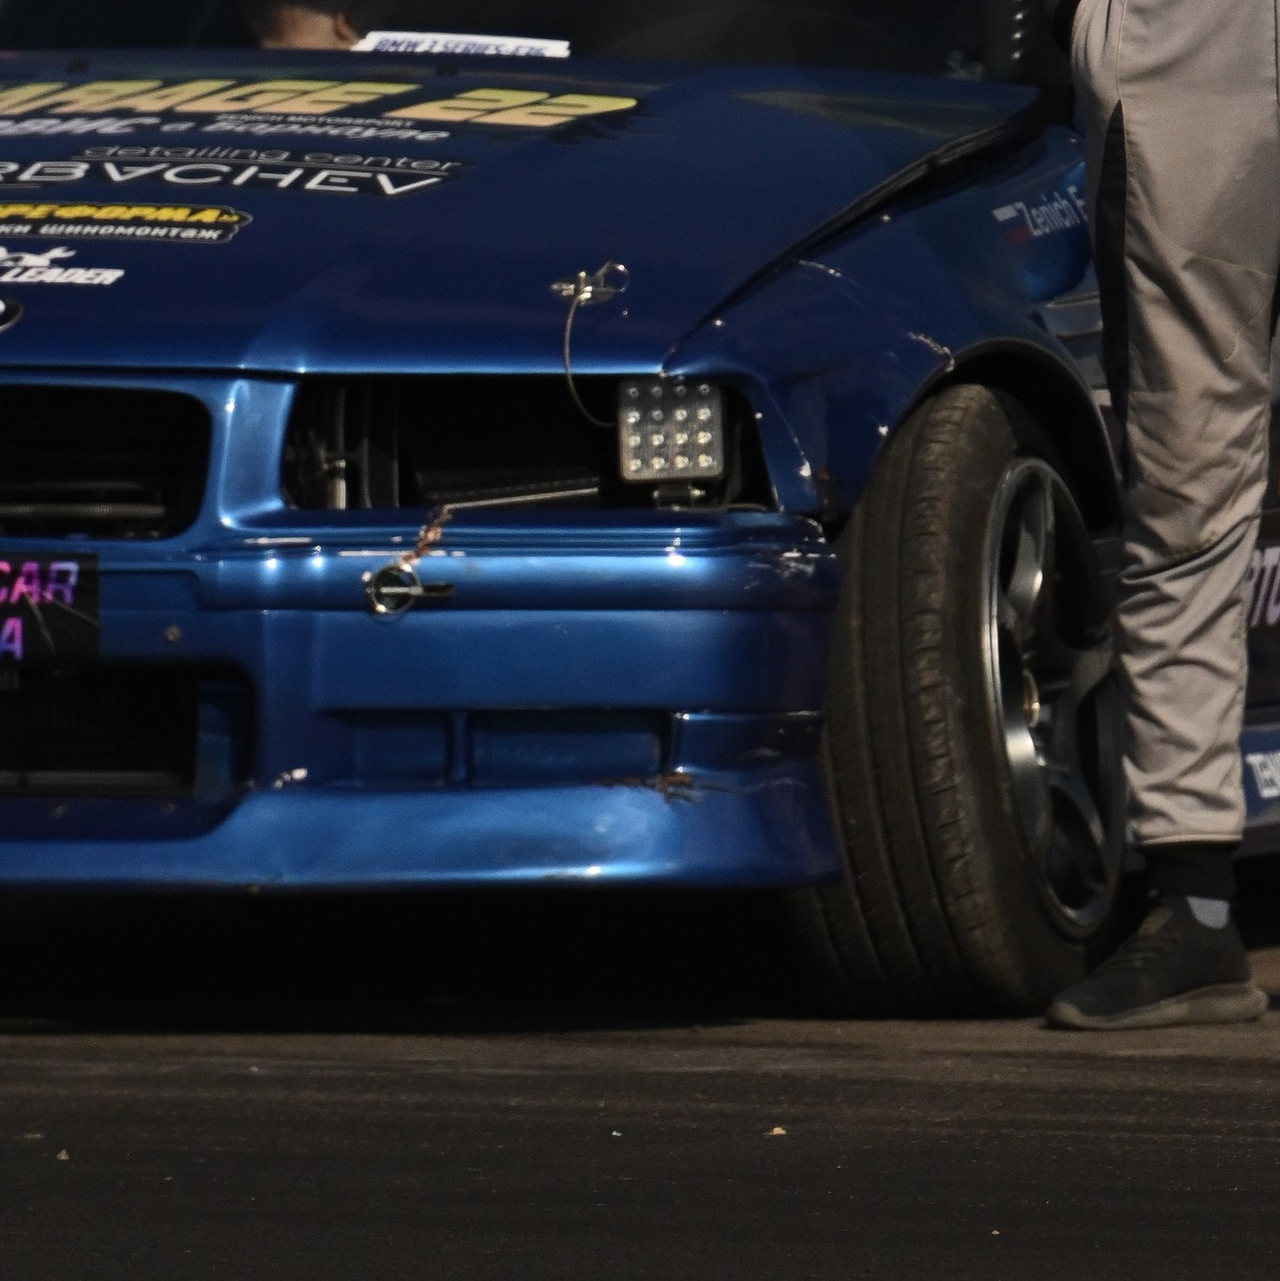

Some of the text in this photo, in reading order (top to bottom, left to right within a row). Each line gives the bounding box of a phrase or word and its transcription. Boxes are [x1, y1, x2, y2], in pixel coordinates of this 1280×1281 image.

[380, 88, 638, 128] 22
[84, 144, 462, 171] detailing center
[1014, 191, 1081, 236] Zenich
[0, 267, 126, 285] LEADER
